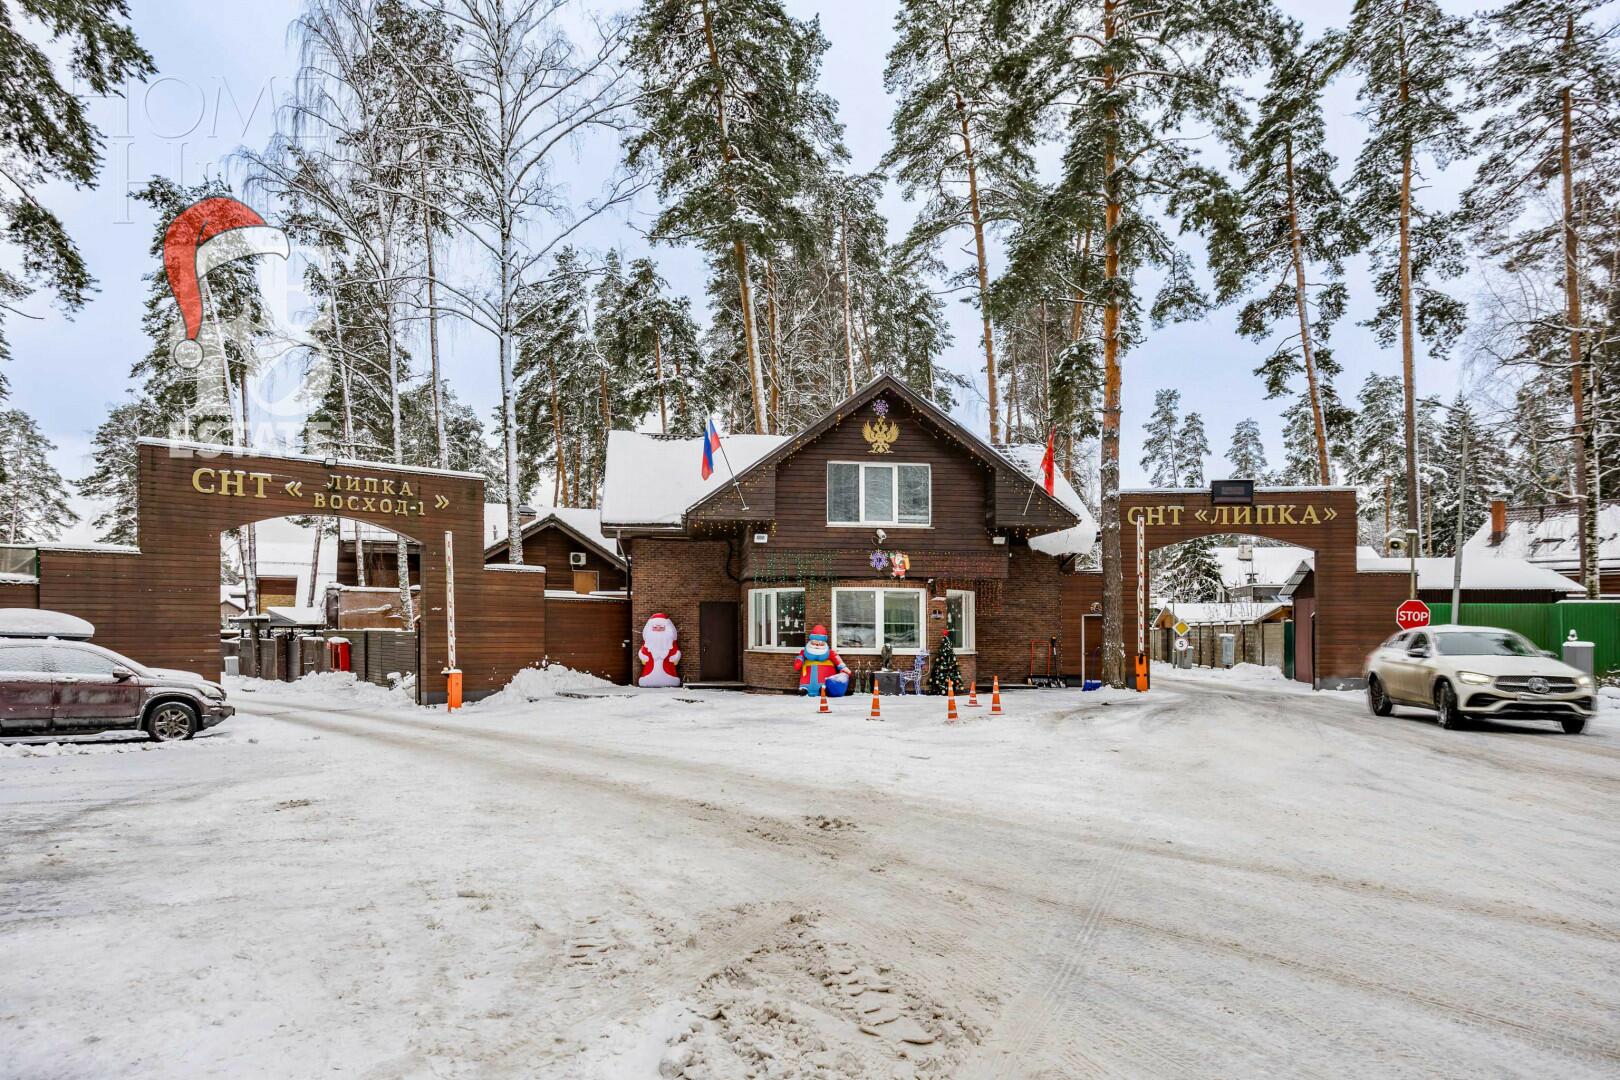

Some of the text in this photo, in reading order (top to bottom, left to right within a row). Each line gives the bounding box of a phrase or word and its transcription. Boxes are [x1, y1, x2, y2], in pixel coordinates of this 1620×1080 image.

[192, 468, 272, 499] СНТ
[327, 474, 414, 497] ЛИПКА
[314, 492, 426, 516] ВОСХОД-1
[1127, 503, 1338, 526] СНТ «ЛИПКА»
[1398, 610, 1429, 622] STOP
[1178, 640, 1184, 648] 5
